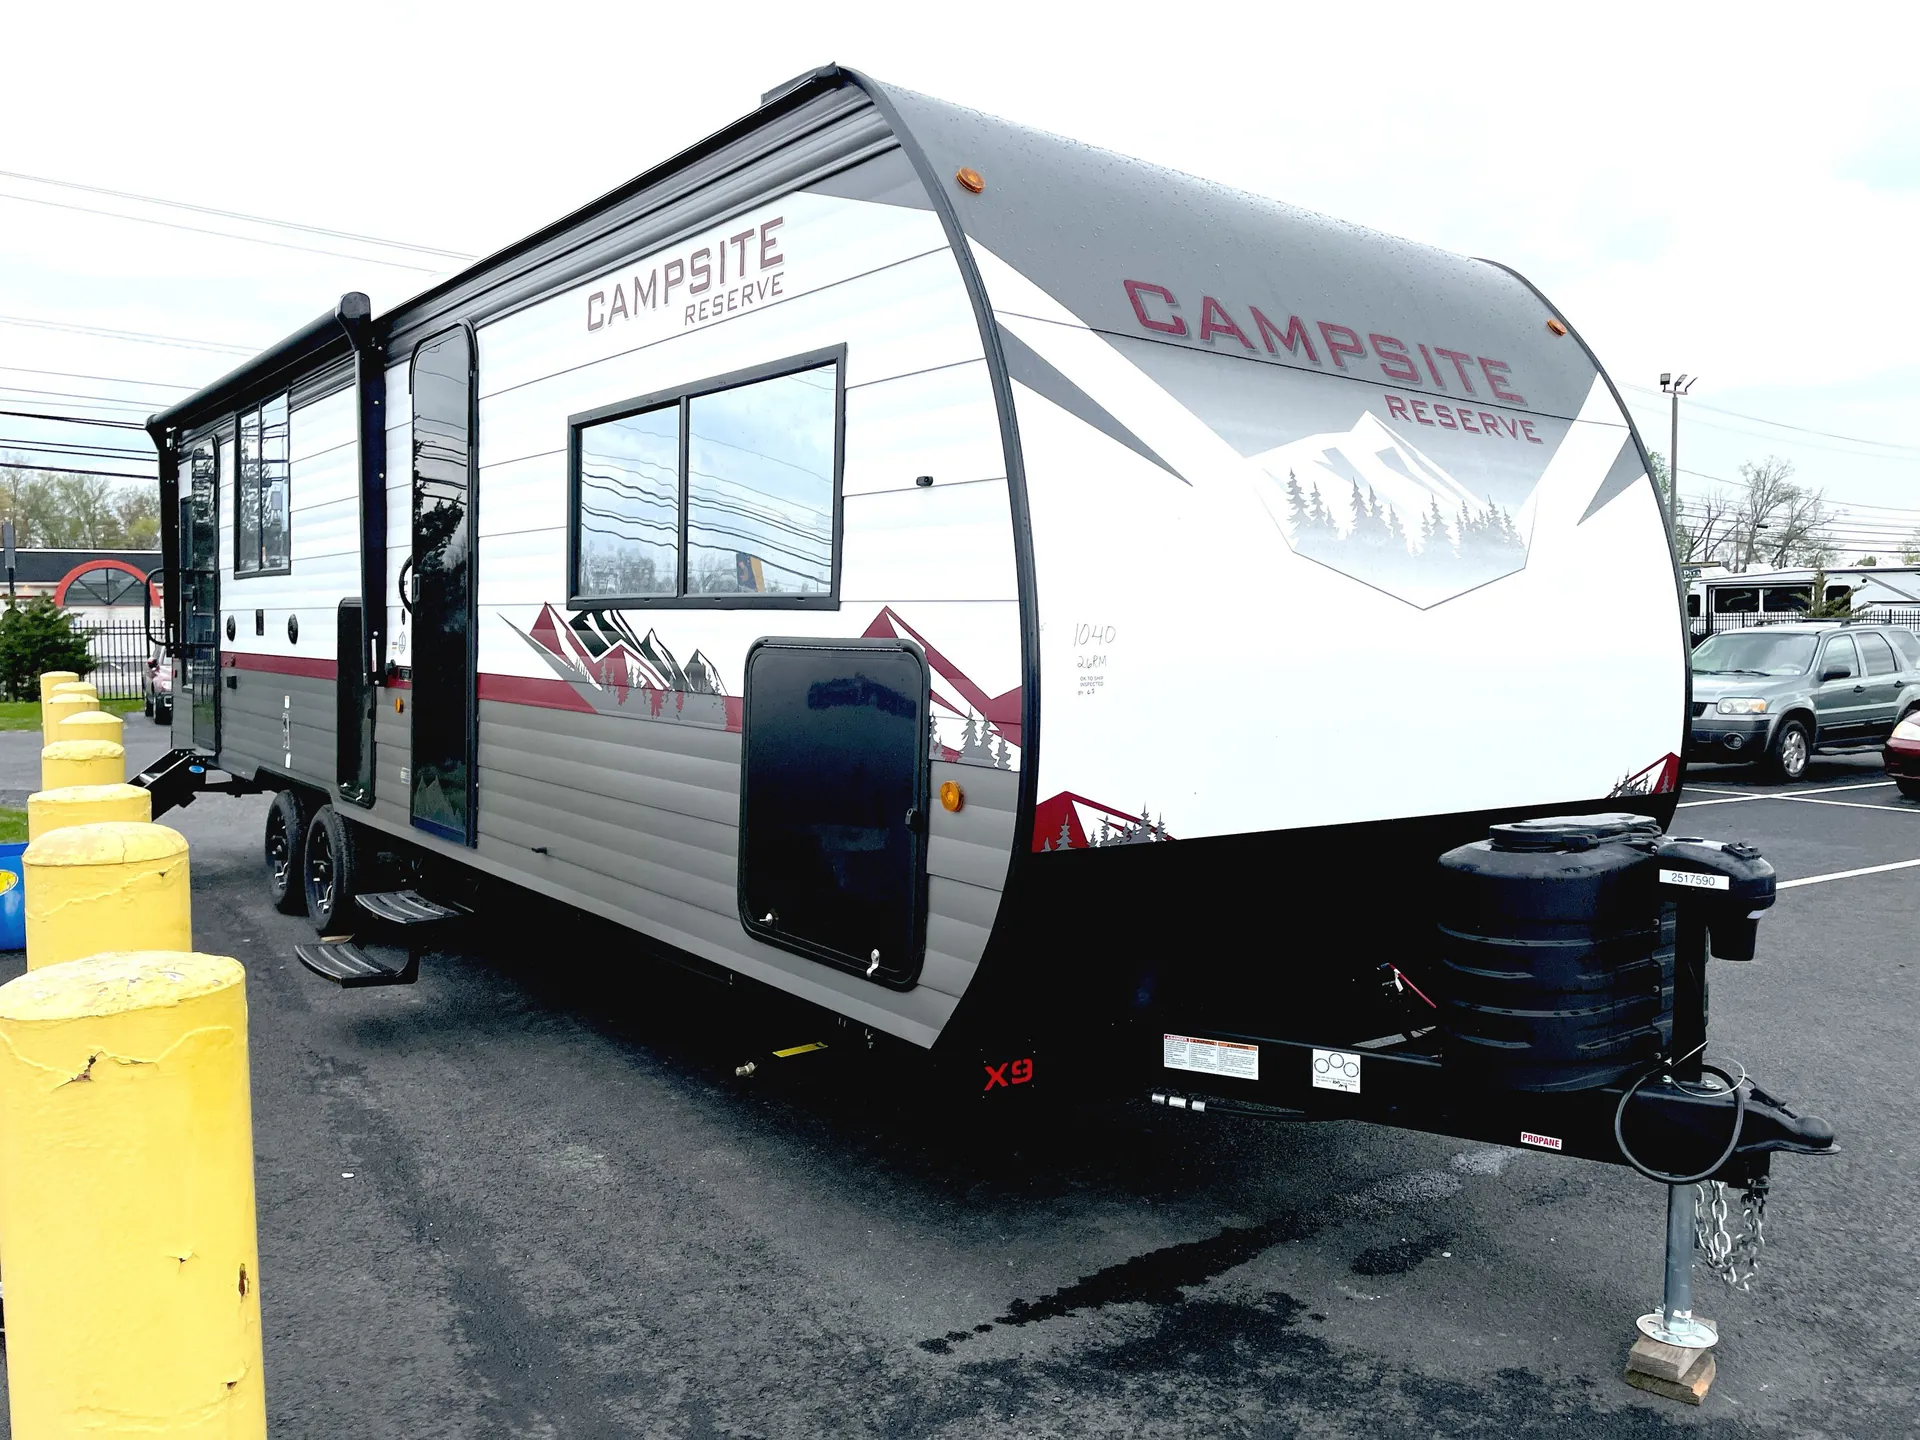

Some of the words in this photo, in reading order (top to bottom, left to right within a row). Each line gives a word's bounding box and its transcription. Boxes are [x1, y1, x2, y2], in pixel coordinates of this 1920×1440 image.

[587, 215, 785, 333] CAMPSITE
[684, 271, 785, 327] RESERVE
[1123, 278, 1527, 405] CAMPSITE
[1384, 394, 1544, 445] RESERVE
[1073, 622, 1117, 648] 1040
[1671, 872, 1716, 887] 2517590
[984, 1058, 1033, 1091] X9
[1522, 1133, 1560, 1148] PROPANE
